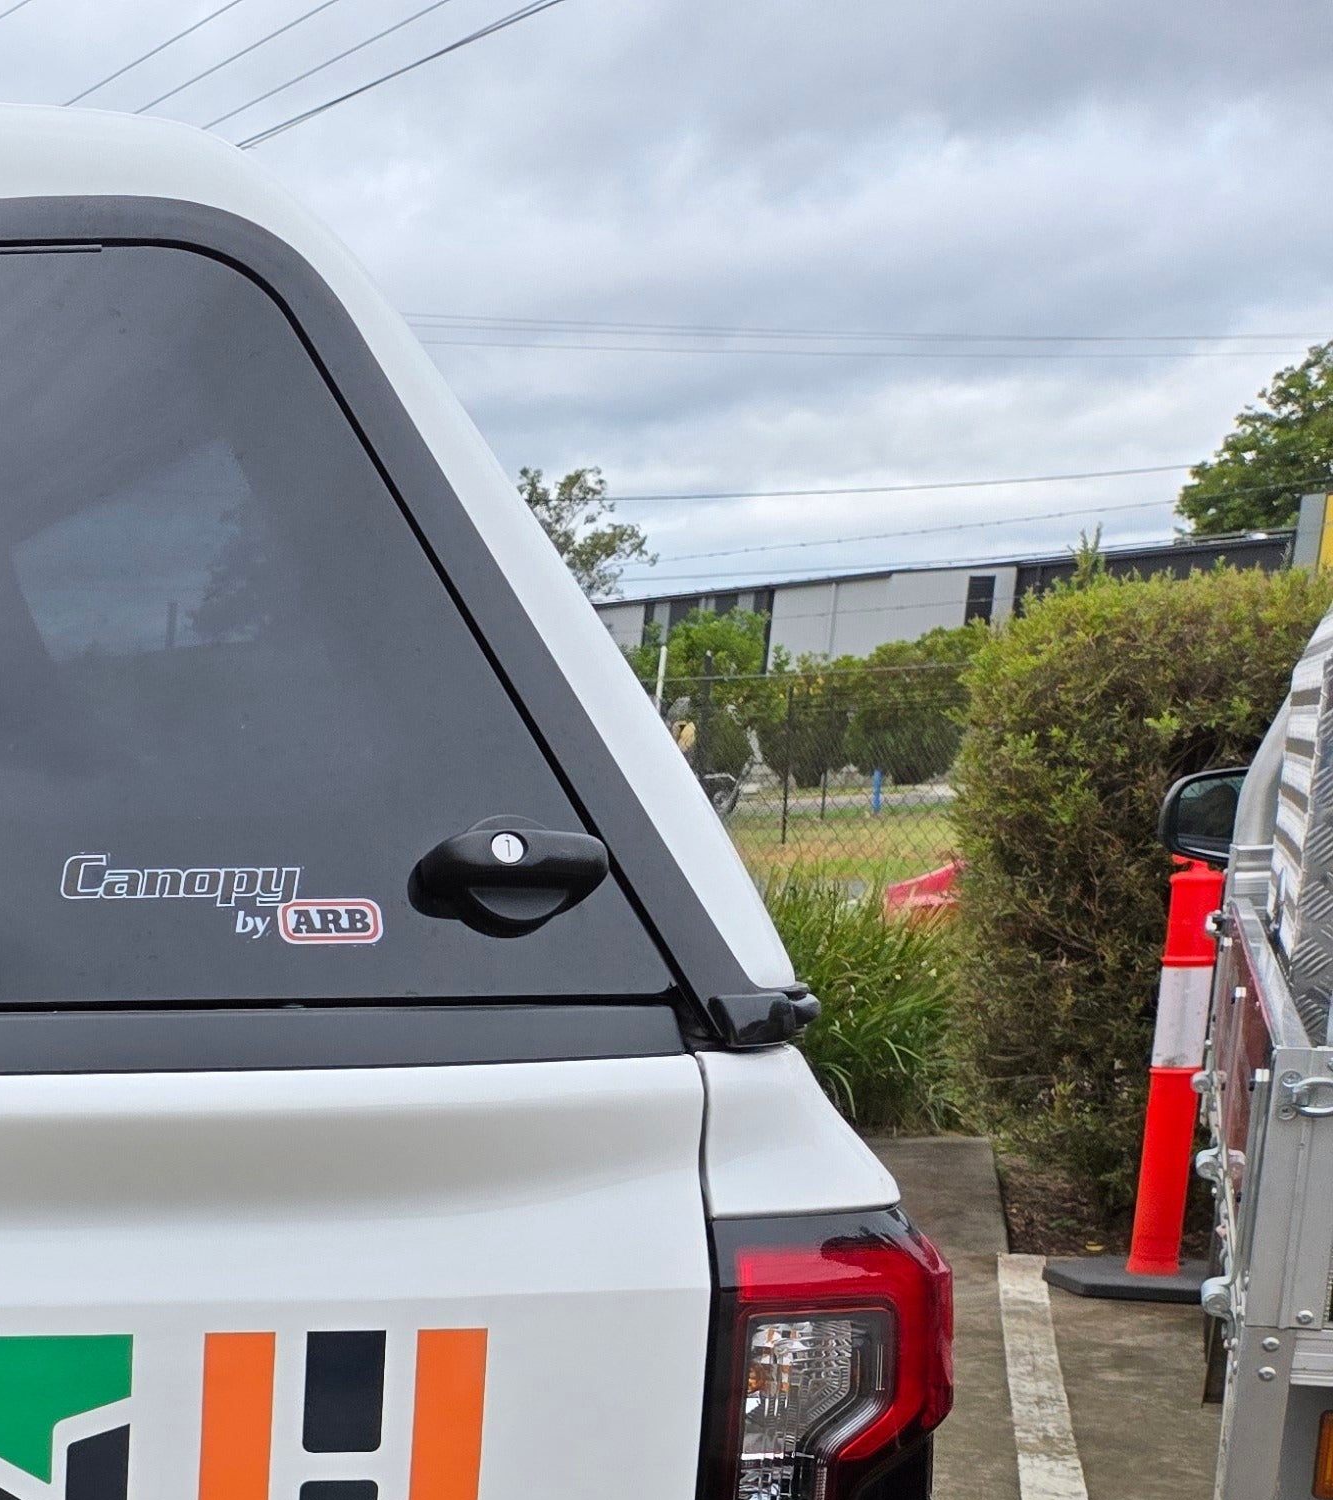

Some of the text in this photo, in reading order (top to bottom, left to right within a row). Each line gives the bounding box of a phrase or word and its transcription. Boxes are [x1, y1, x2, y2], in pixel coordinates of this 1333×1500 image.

[60, 854, 301, 907] Canopy
[235, 908, 372, 939] by ARB
